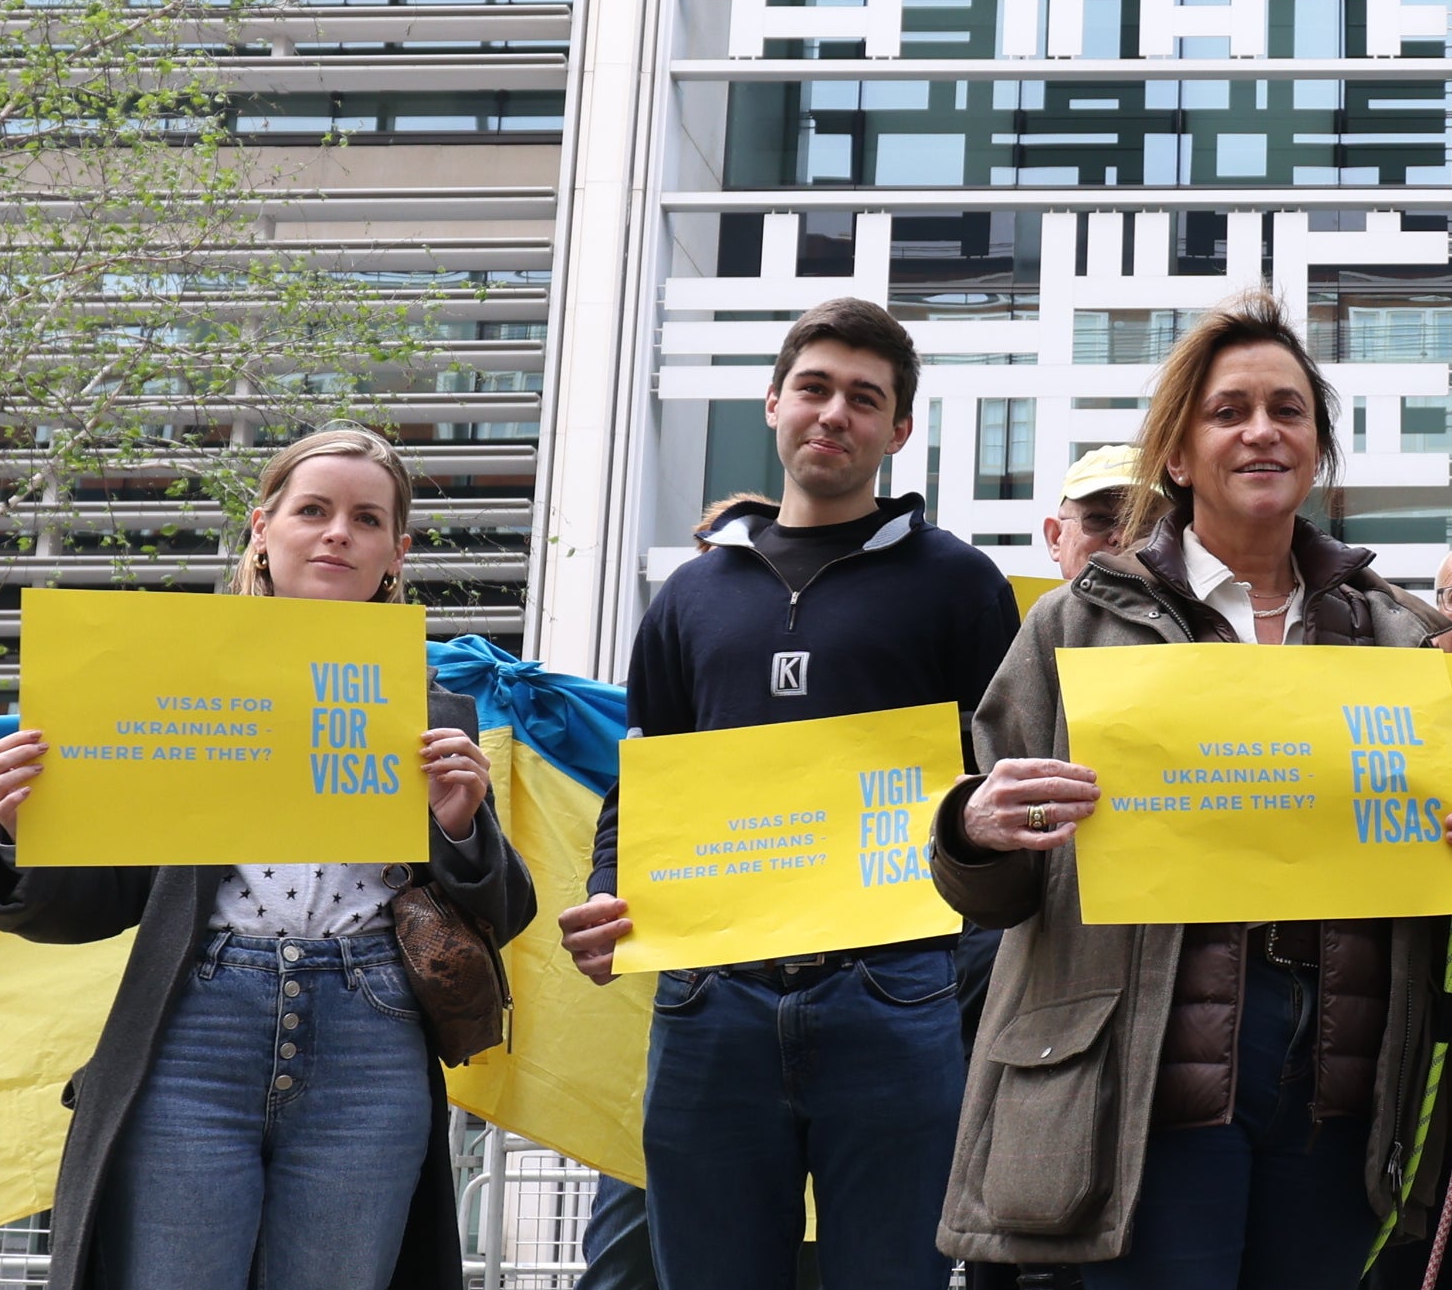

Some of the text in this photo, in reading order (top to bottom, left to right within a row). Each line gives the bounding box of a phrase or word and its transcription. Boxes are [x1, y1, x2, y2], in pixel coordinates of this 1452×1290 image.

[310, 662, 388, 704] VIGIL
[779, 657, 800, 689] K
[156, 697, 272, 711] VISAS FOR
[116, 722, 257, 736] UKRAINIANS
[312, 708, 367, 749] FOR
[1342, 705, 1424, 745] VIGIL
[60, 745, 272, 761] WHERE ARE THEY?
[1199, 742, 1312, 757] VISAS FOR
[310, 753, 400, 795] VISAS
[1163, 769, 1300, 783] UKRAINIANS
[1350, 751, 1408, 793] FOR
[860, 767, 929, 808] VIGIL
[1112, 795, 1316, 811] WHERE ARE THEY?
[728, 811, 826, 831] VISAS FOR
[861, 809, 909, 848] FOR
[1353, 798, 1442, 843] VISAS
[696, 833, 814, 856] UKRAINIANS
[650, 854, 826, 883] WHERE ARE THEY?
